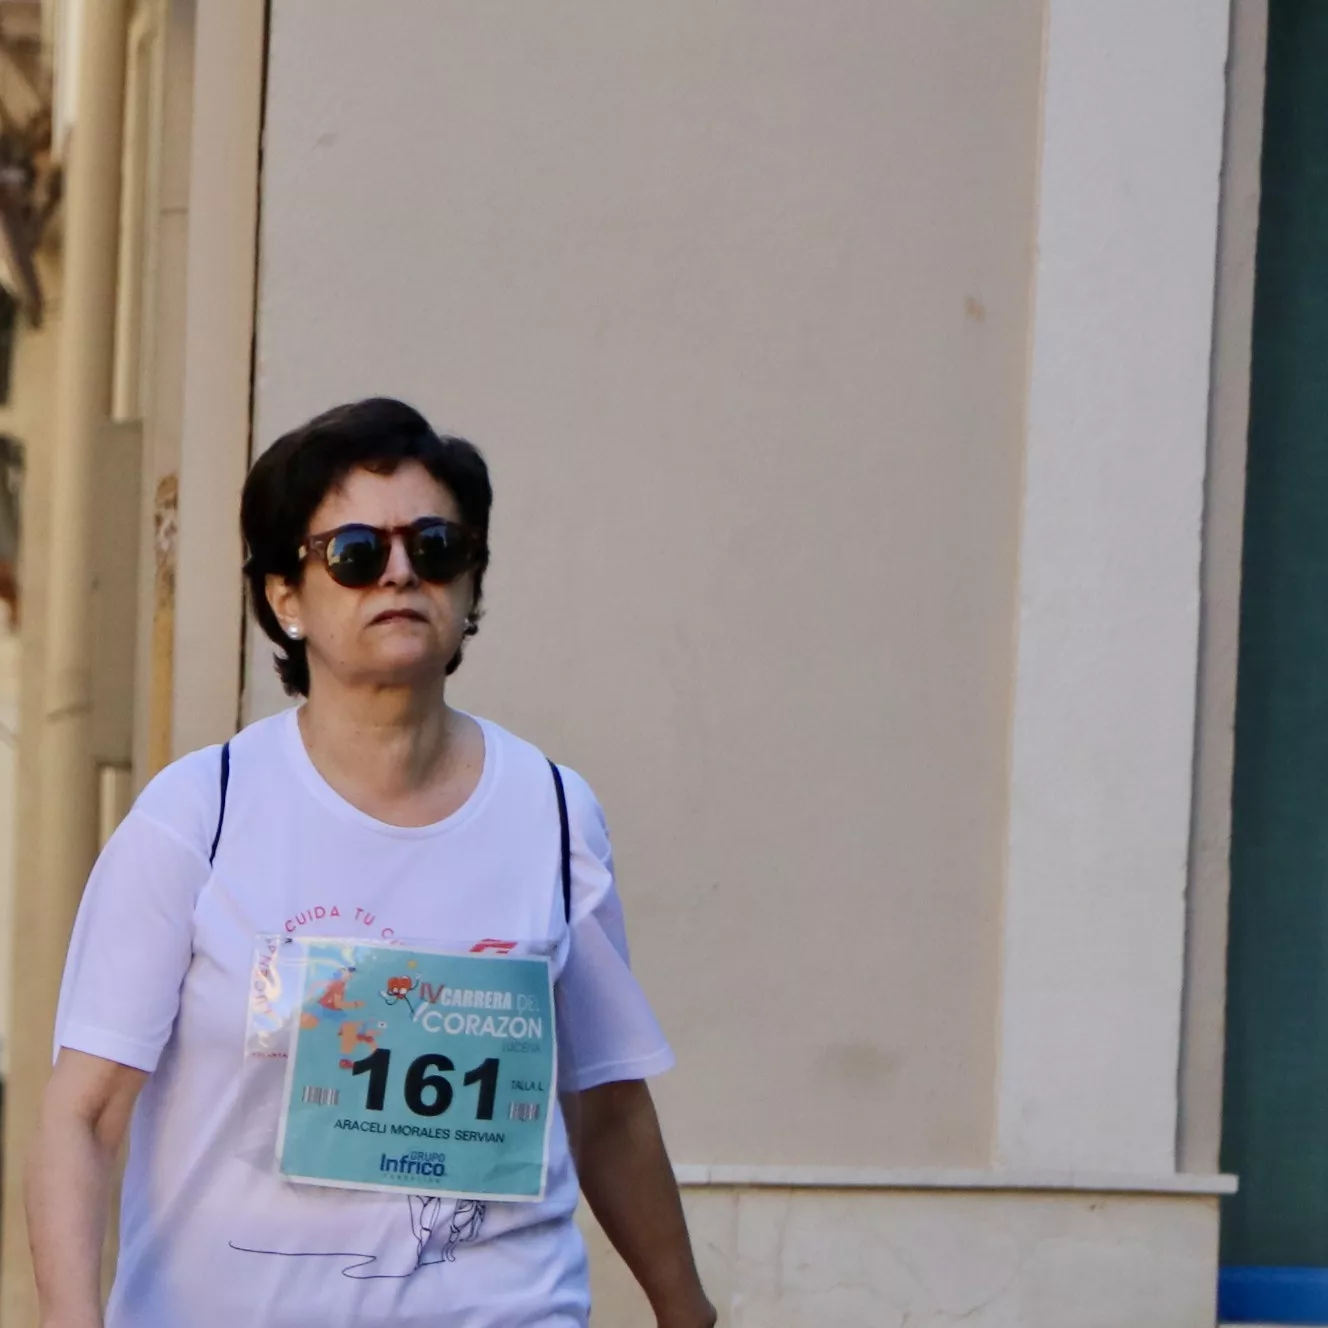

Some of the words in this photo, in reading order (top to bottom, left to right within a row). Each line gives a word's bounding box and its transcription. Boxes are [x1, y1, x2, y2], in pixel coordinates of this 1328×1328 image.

[284, 905, 340, 933] CUIDA
[354, 907, 376, 926] TU
[419, 982, 445, 1004] IV
[442, 987, 512, 1010] CARRERA
[351, 1047, 500, 1121] 161
[333, 1119, 387, 1134] ARACELI
[390, 1124, 450, 1140] MORALES
[454, 1130, 505, 1144] SERVIAN
[380, 1153, 445, 1176] Infrico
[410, 1151, 446, 1163] GRUPO
